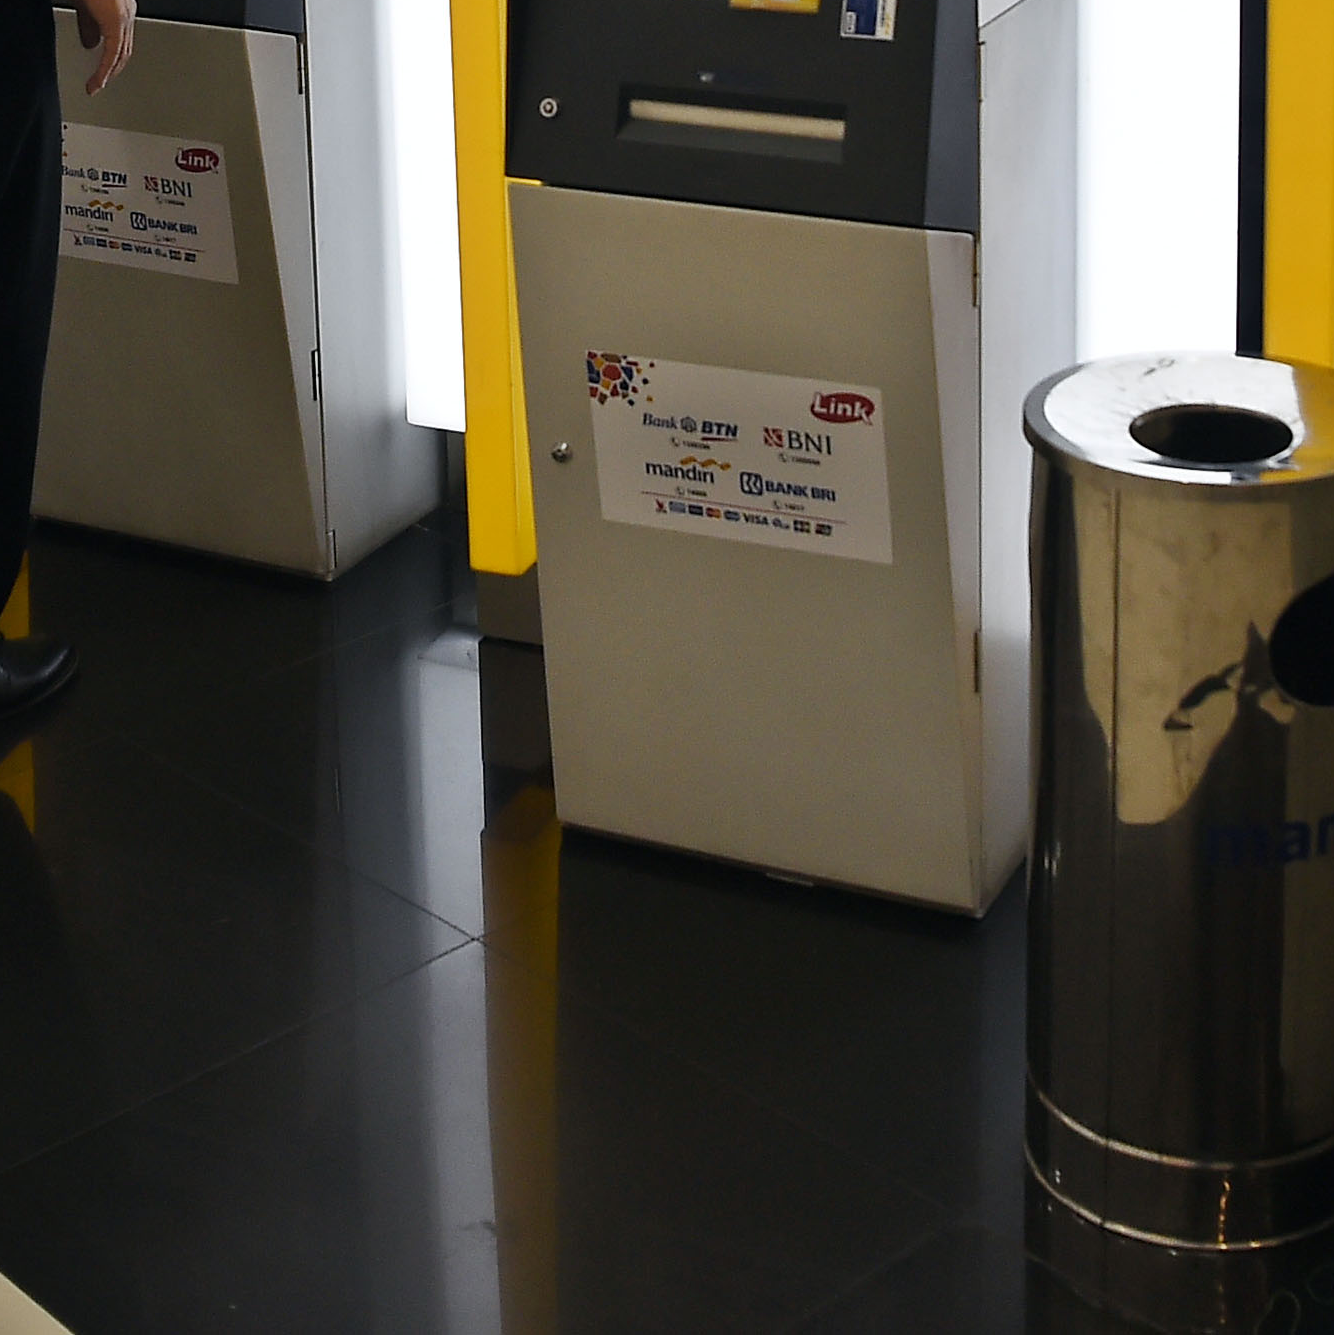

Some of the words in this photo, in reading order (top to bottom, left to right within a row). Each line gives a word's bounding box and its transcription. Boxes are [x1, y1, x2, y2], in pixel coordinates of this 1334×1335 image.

[177, 147, 219, 174] Link
[102, 171, 127, 184] BTN
[161, 178, 193, 198] BNI
[65, 205, 113, 222] mandiri
[148, 218, 178, 233] BANK
[180, 223, 198, 235] BRI
[813, 392, 873, 426] Link
[642, 412, 678, 431] Bank
[700, 420, 738, 438] BTN
[786, 430, 833, 456] BNI
[645, 461, 715, 484] mandiri
[765, 480, 810, 499] BANK
[811, 488, 836, 502] BRI
[742, 512, 769, 527] VISA
